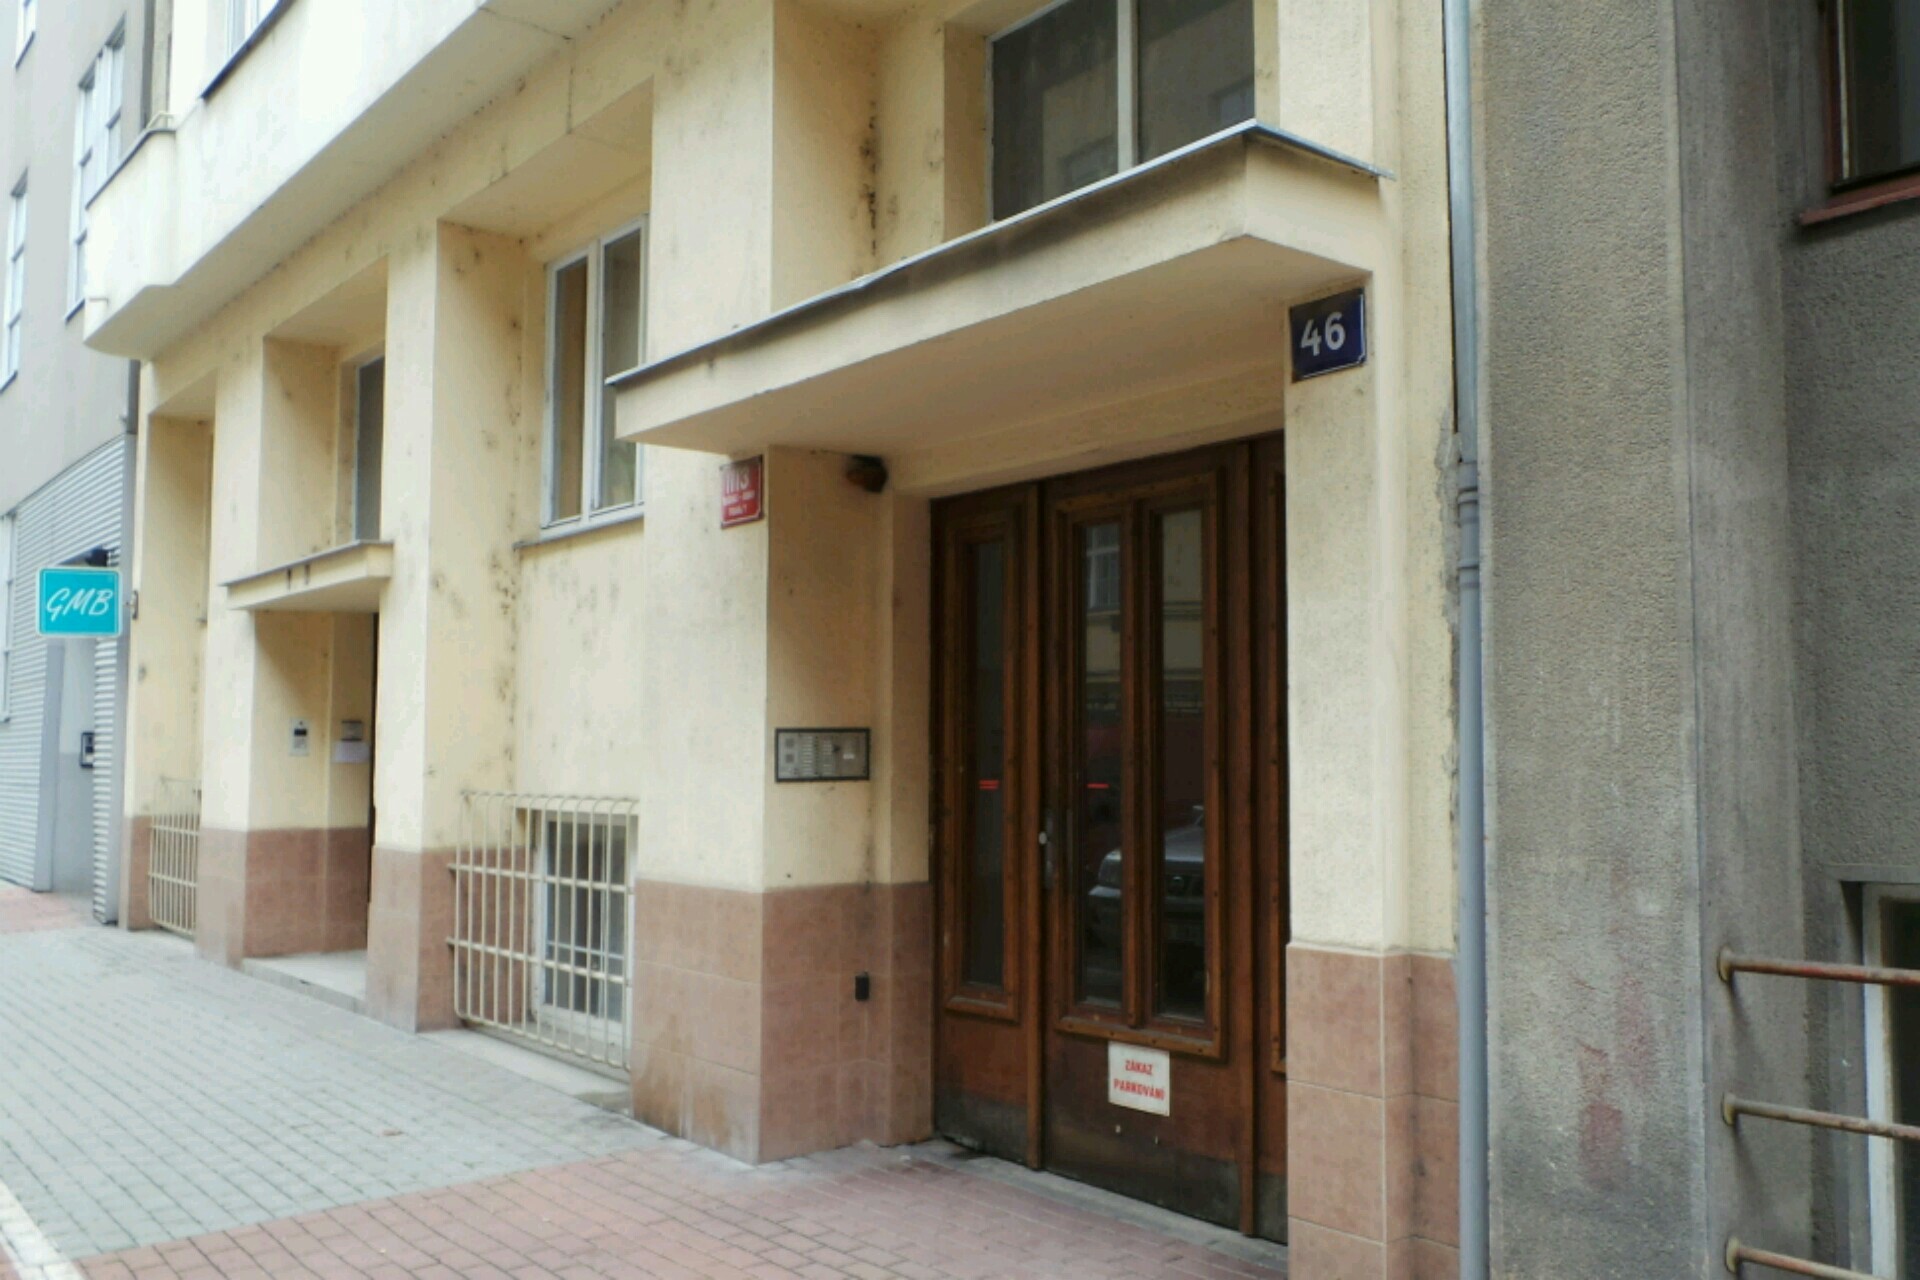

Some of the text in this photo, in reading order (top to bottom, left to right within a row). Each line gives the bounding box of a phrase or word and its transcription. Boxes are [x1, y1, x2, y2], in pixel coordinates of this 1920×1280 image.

[1300, 311, 1346, 357] 46
[46, 587, 114, 622] GMB
[1125, 1059, 1153, 1076] ZÁKAZ
